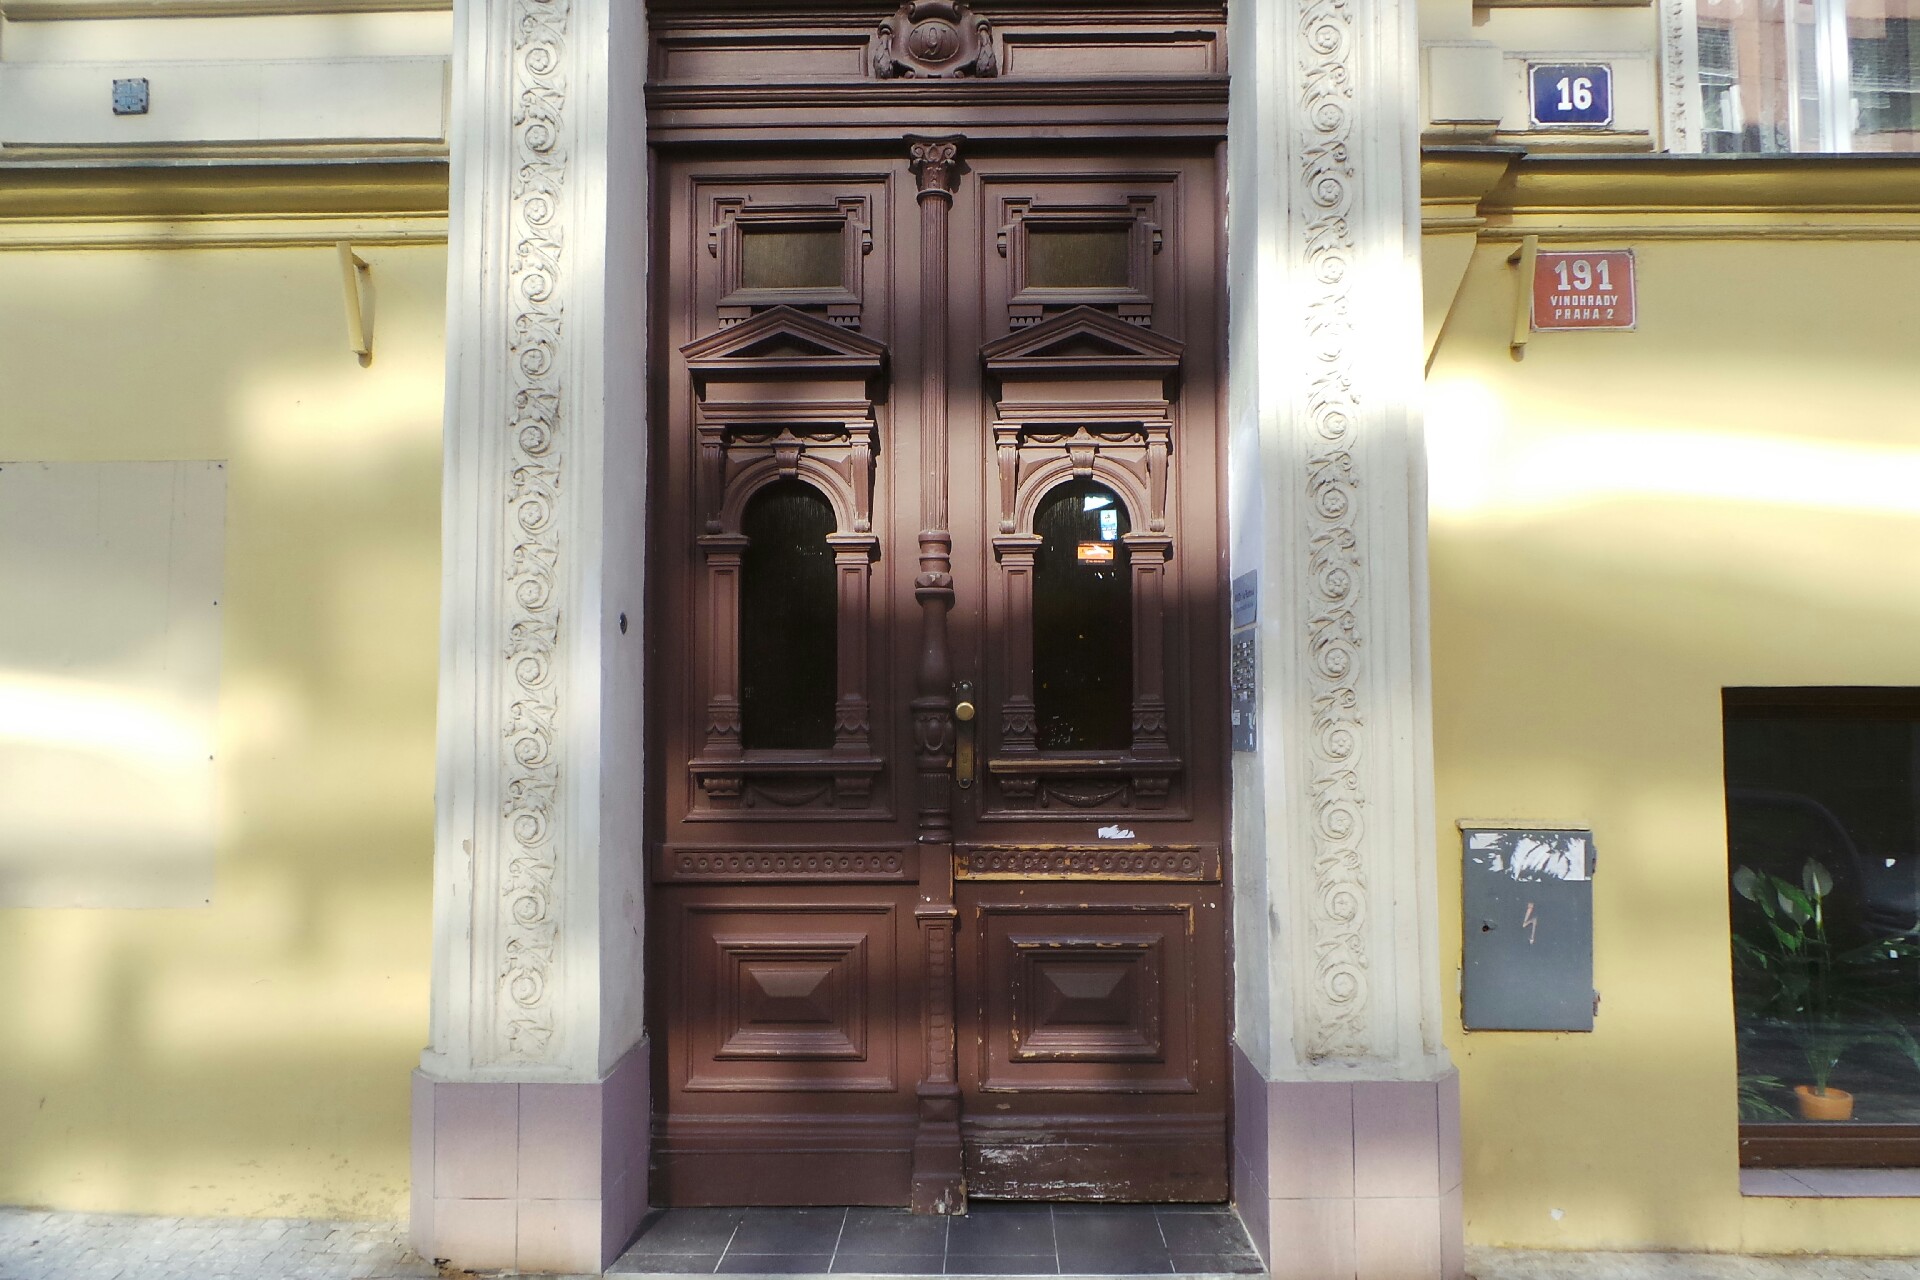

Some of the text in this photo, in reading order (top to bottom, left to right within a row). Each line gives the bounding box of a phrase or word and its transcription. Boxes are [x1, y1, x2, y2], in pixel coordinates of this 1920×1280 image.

[1556, 77, 1592, 111] 16
[1554, 259, 1613, 291] 191
[1550, 295, 1618, 306] VINOHRADY
[1555, 308, 1614, 320] PRAHA 2
